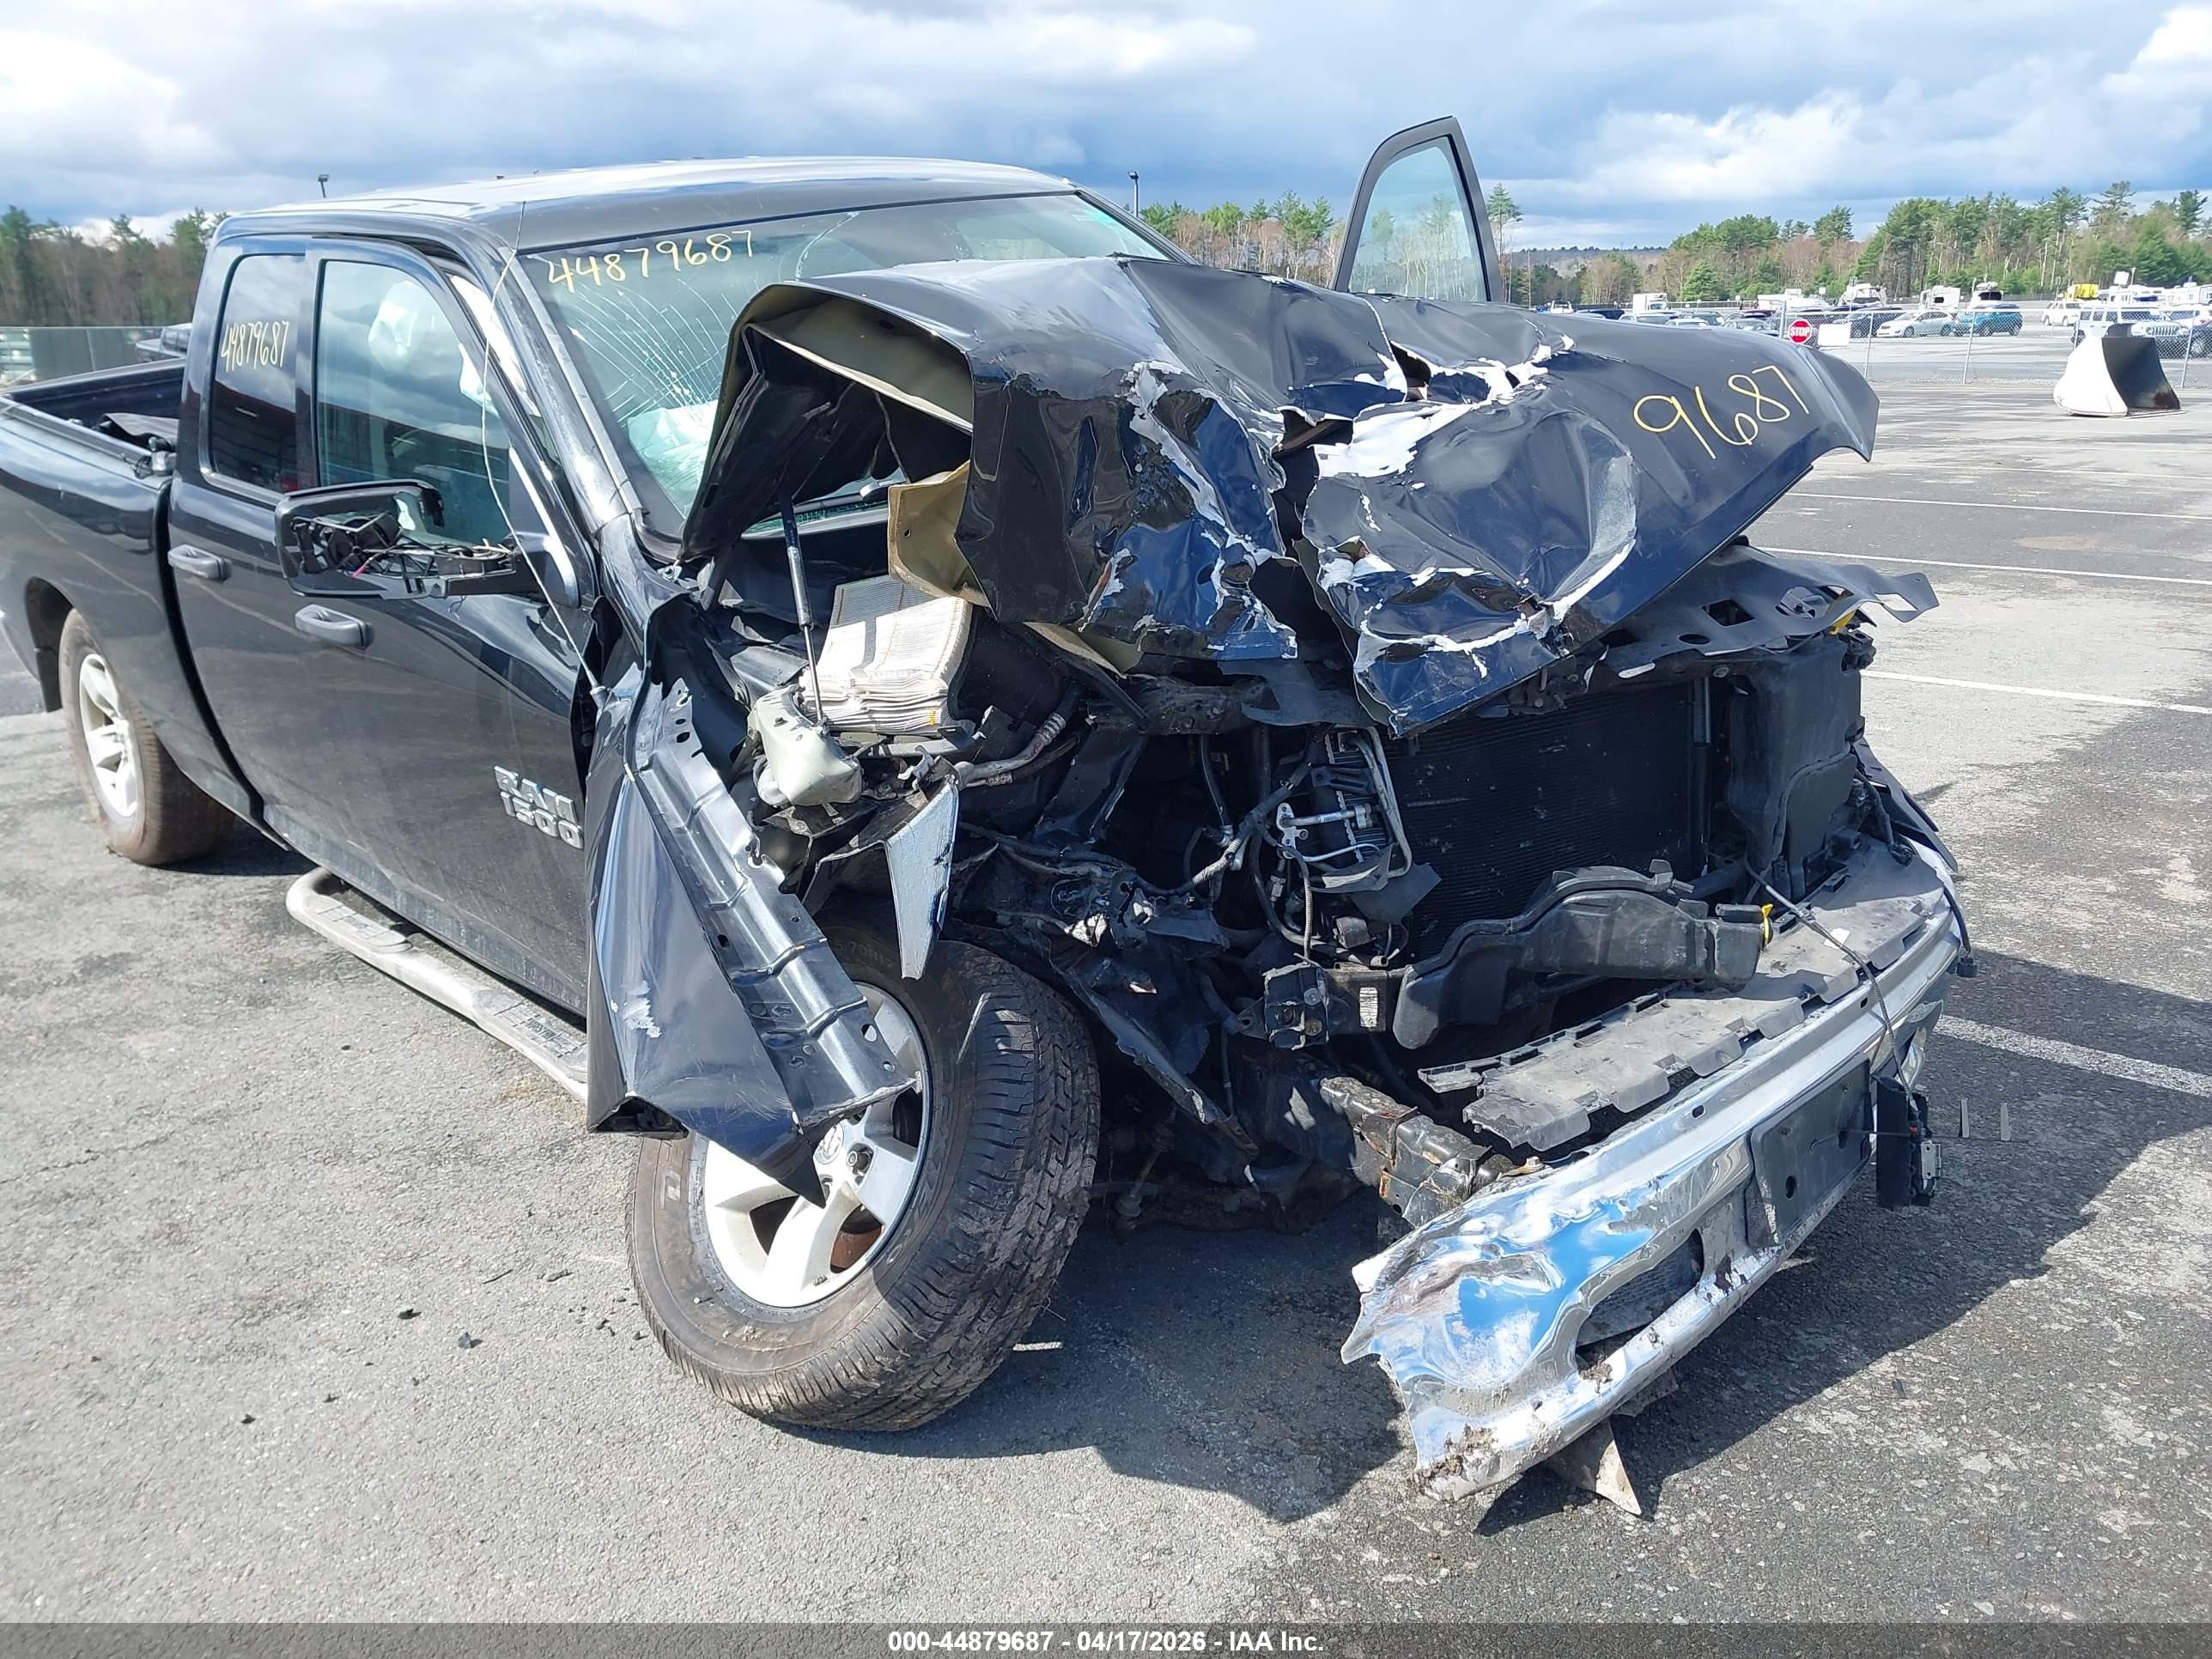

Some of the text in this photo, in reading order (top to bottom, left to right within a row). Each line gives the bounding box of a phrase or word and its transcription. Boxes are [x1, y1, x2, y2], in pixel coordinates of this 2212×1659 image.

[548, 229, 753, 294] 44879687
[221, 320, 289, 373] 44879687
[1790, 326, 1810, 337] STOP
[1633, 365, 1809, 459] 9687
[494, 765, 579, 823] RAM
[500, 791, 585, 850] 1500
